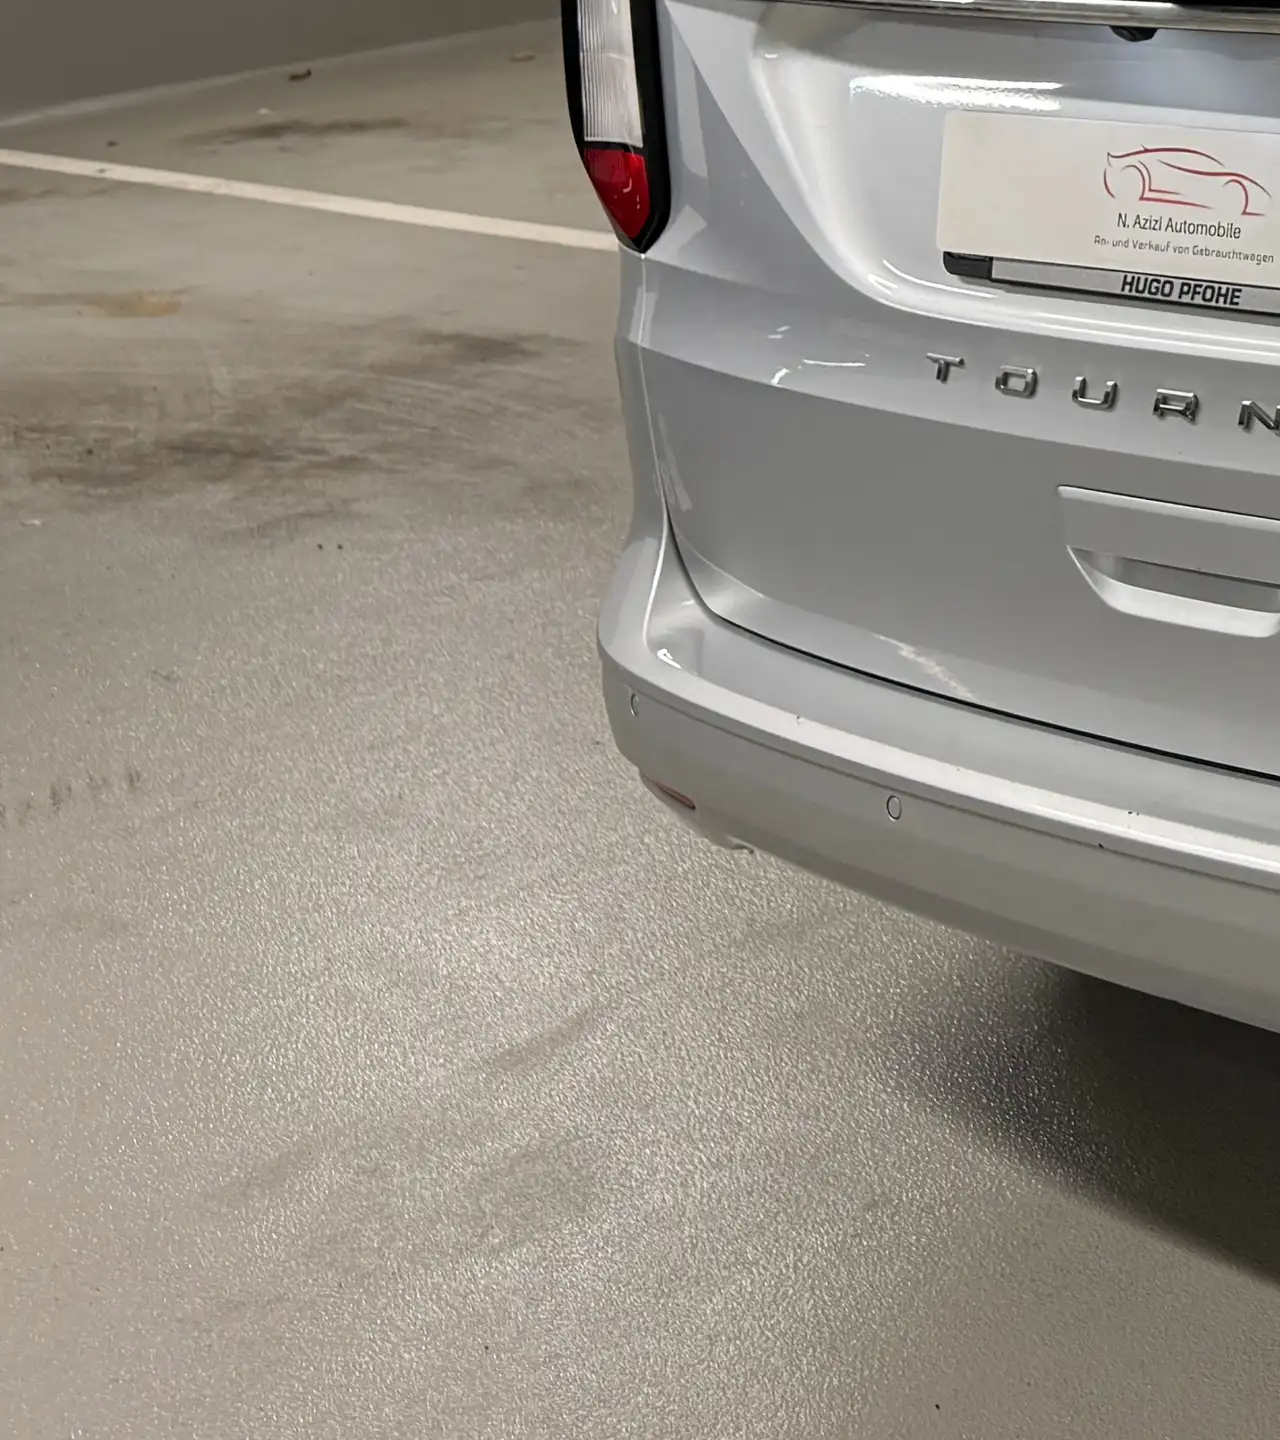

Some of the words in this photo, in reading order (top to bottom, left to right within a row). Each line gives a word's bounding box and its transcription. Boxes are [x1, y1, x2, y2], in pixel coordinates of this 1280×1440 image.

[1117, 212, 1130, 228] N.
[1132, 214, 1162, 232] Azizi
[1165, 217, 1242, 240] Automobile
[1112, 238, 1130, 249] und
[1132, 240, 1171, 253] Verkauf
[1172, 246, 1190, 255] von
[1192, 245, 1275, 265] Gebrauchtwagen
[1120, 274, 1175, 298] HUGO
[1178, 281, 1243, 306] PFOHE
